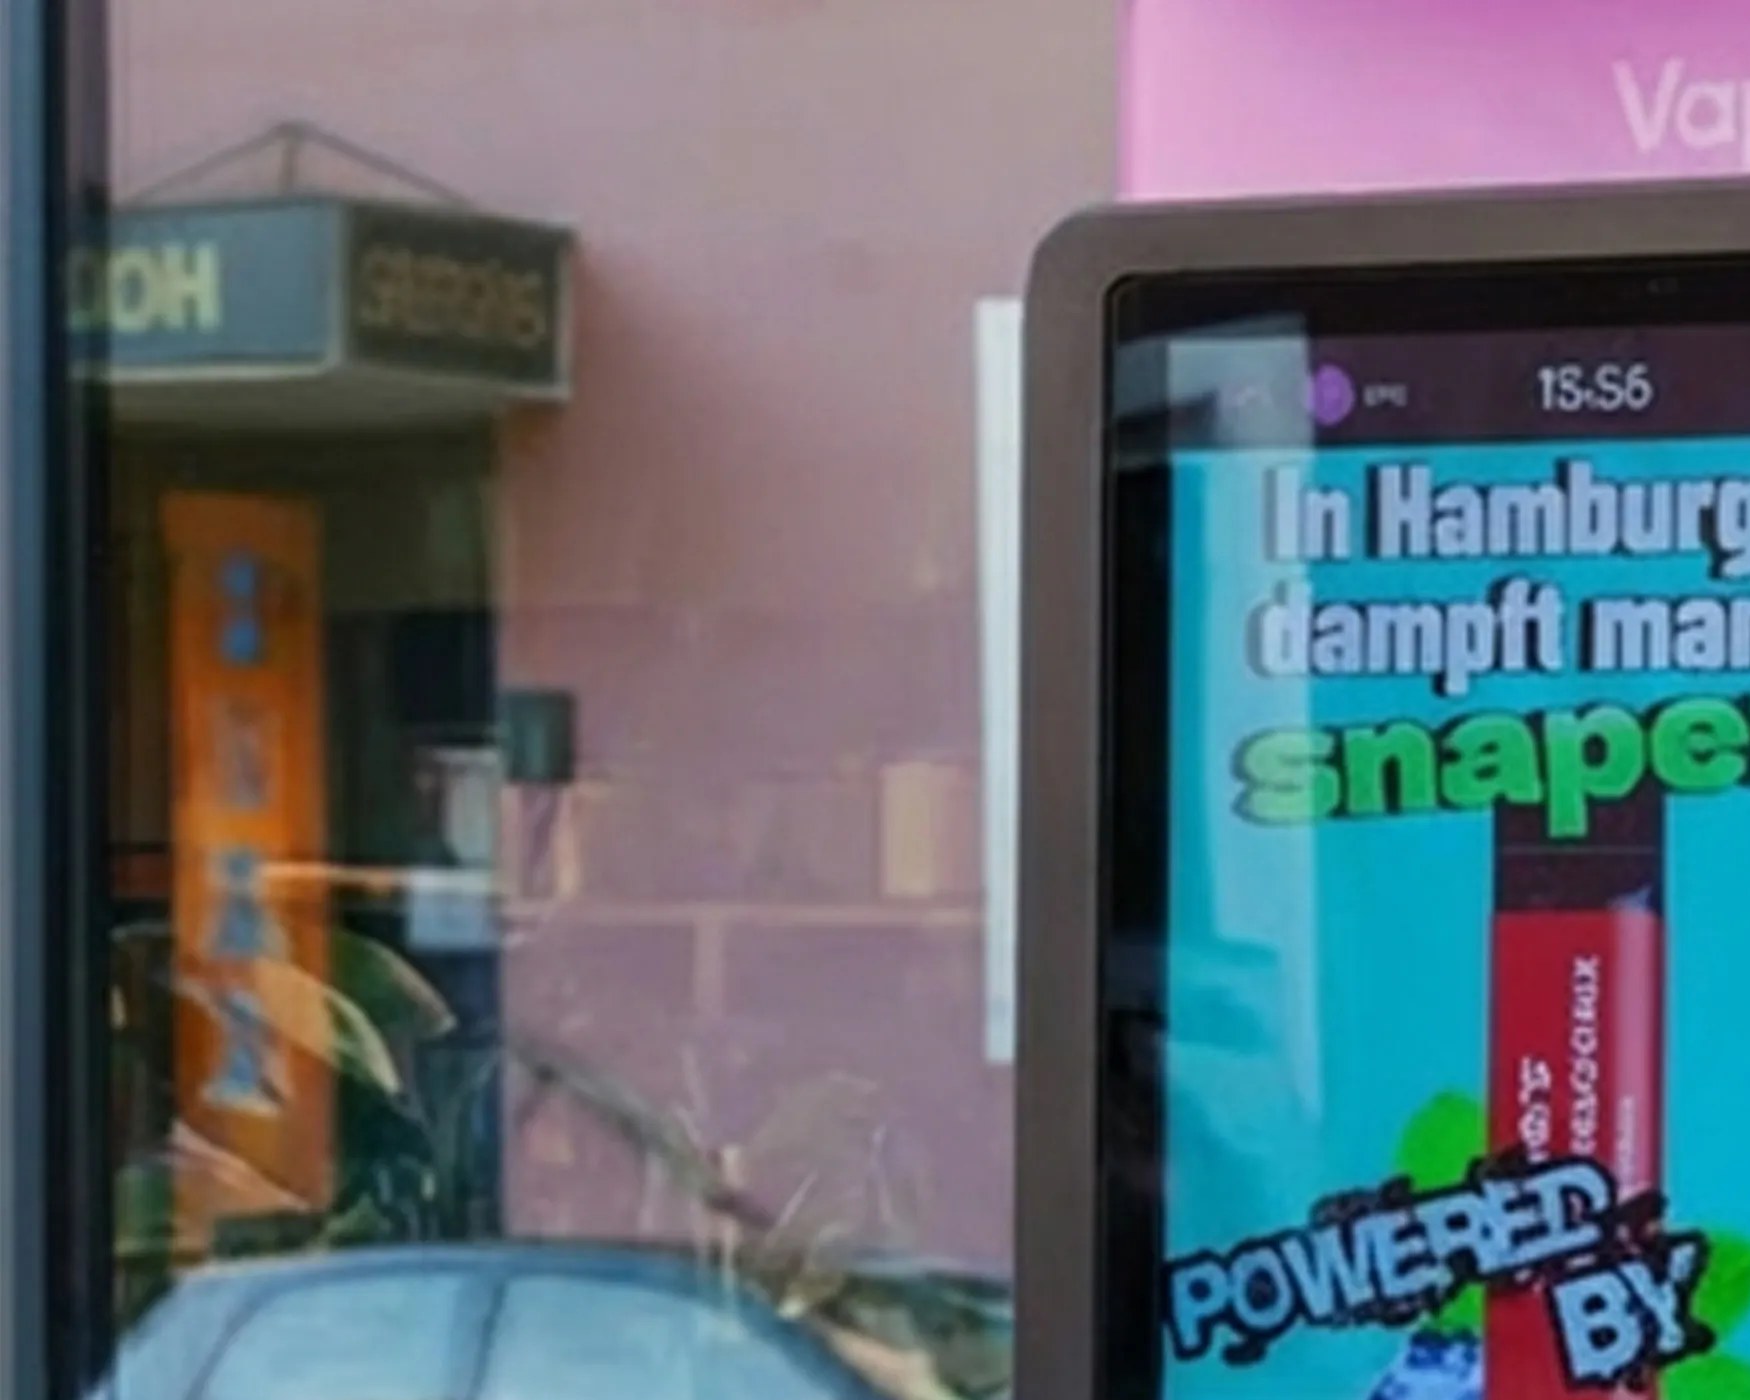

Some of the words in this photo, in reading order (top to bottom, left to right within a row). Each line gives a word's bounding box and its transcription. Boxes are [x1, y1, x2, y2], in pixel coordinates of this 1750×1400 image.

[1266, 462, 1351, 563] In
[1250, 578, 1566, 696] dampft
[1167, 1163, 1612, 1352] POWERED
[1553, 1241, 1697, 1381] BY
